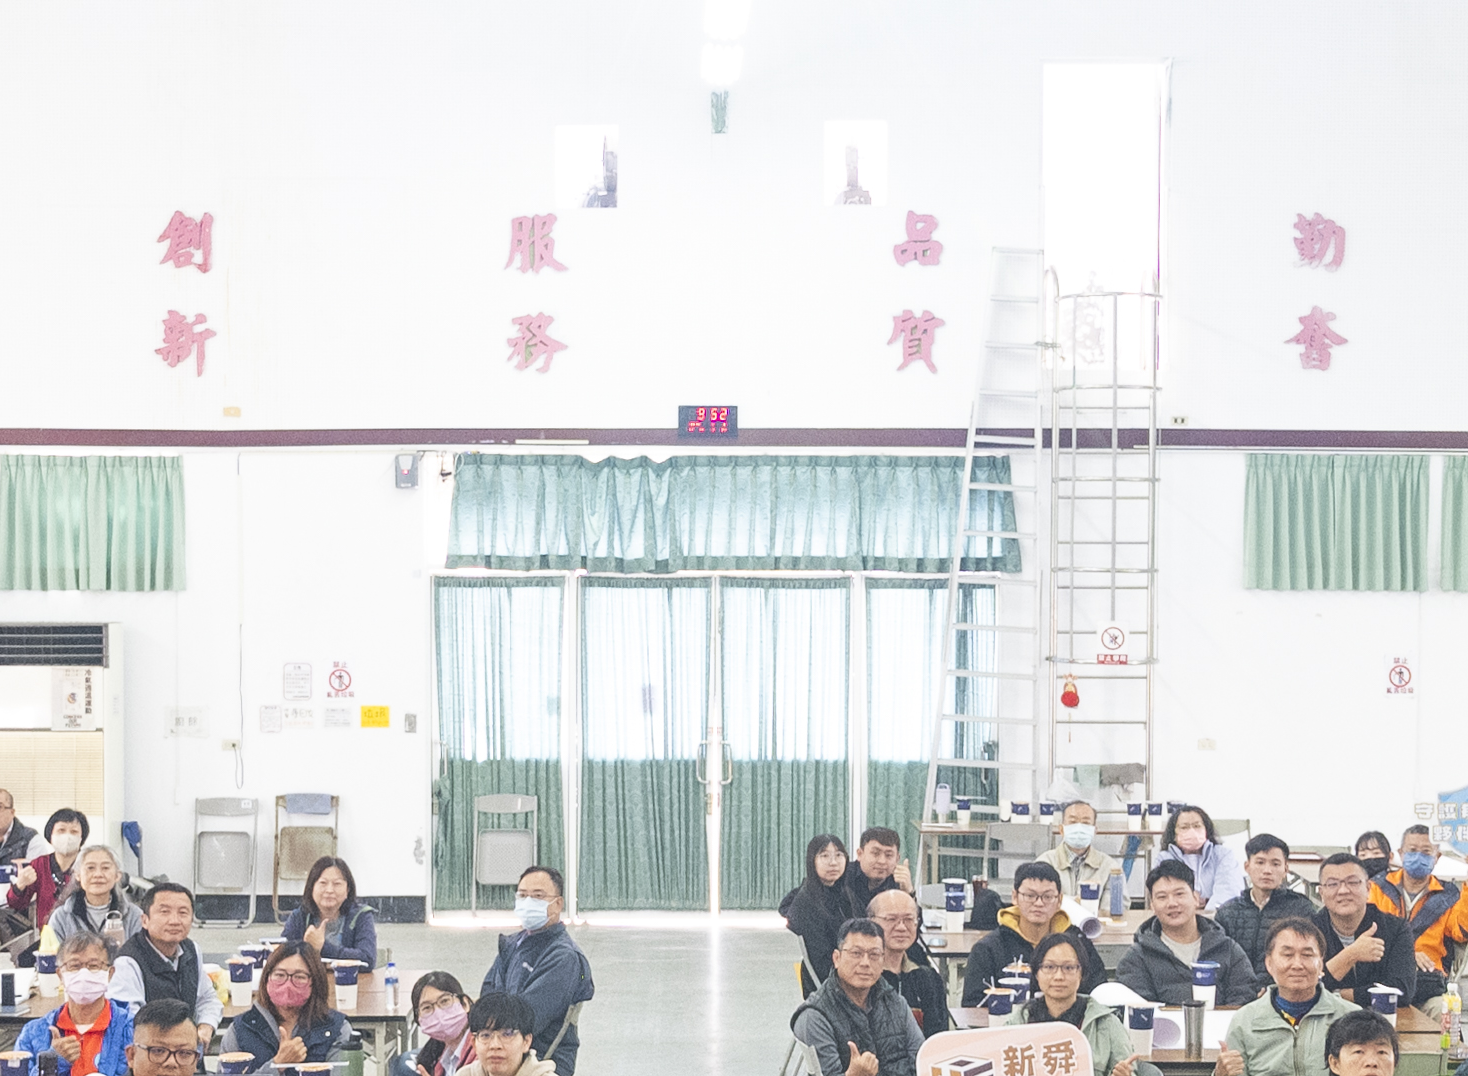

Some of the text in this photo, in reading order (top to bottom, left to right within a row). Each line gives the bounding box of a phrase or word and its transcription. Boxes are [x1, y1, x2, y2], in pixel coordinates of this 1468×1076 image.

[154, 209, 217, 377] 創新
[503, 211, 569, 374] 服務
[886, 209, 946, 375] 品質
[1283, 211, 1349, 371] 勤奮
